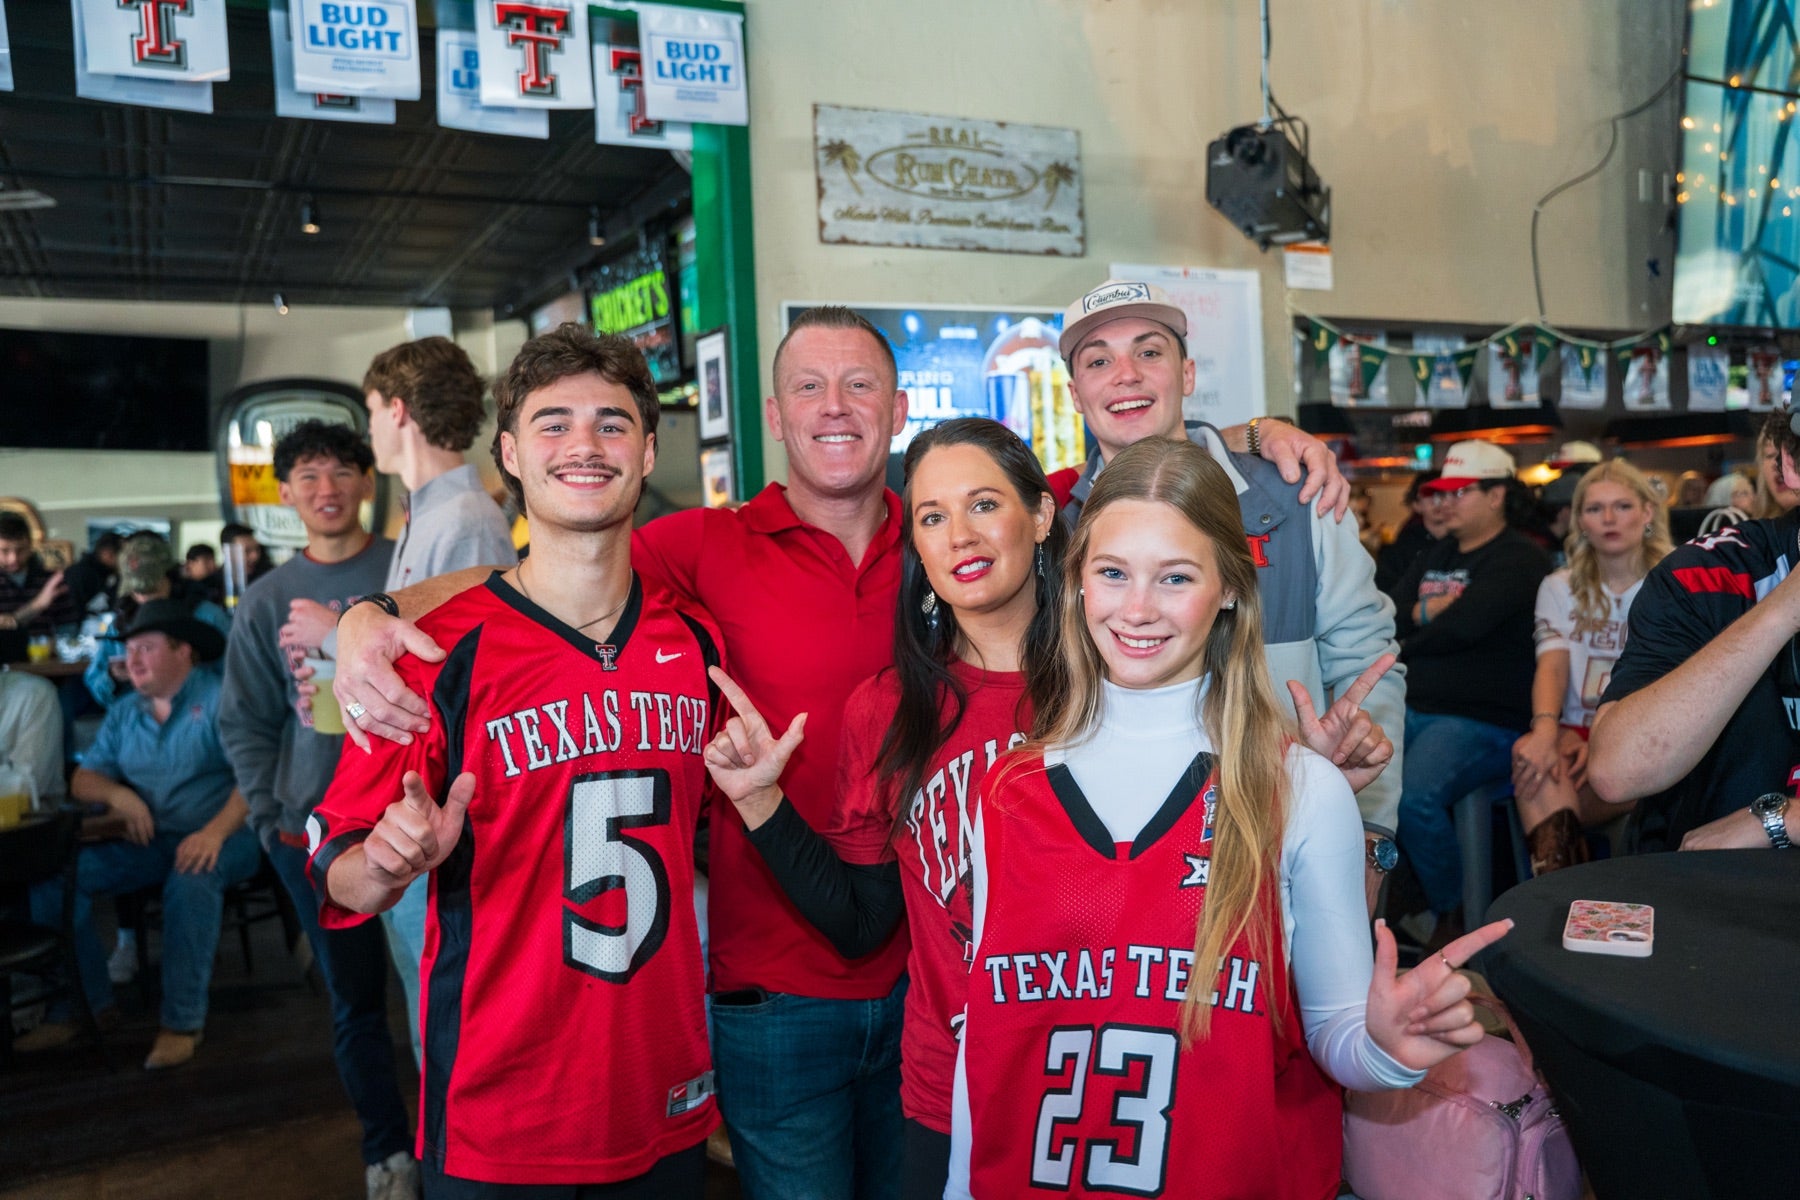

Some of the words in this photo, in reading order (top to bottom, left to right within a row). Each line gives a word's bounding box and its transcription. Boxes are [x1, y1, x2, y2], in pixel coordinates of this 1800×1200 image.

[321, 3, 388, 27] BUD
[309, 24, 402, 52] LIGHT
[665, 41, 721, 62] BUD
[656, 60, 732, 83] LIGHT
[929, 127, 983, 148] REAL
[1086, 287, 1131, 311] Columbia
[898, 370, 954, 386] RING
[486, 689, 623, 778] TEXAS
[629, 691, 709, 756] TECH
[905, 731, 1029, 911] TEX
[563, 768, 671, 985] 5
[984, 947, 1117, 1004] TEXAS
[1029, 1021, 1182, 1199] 23
